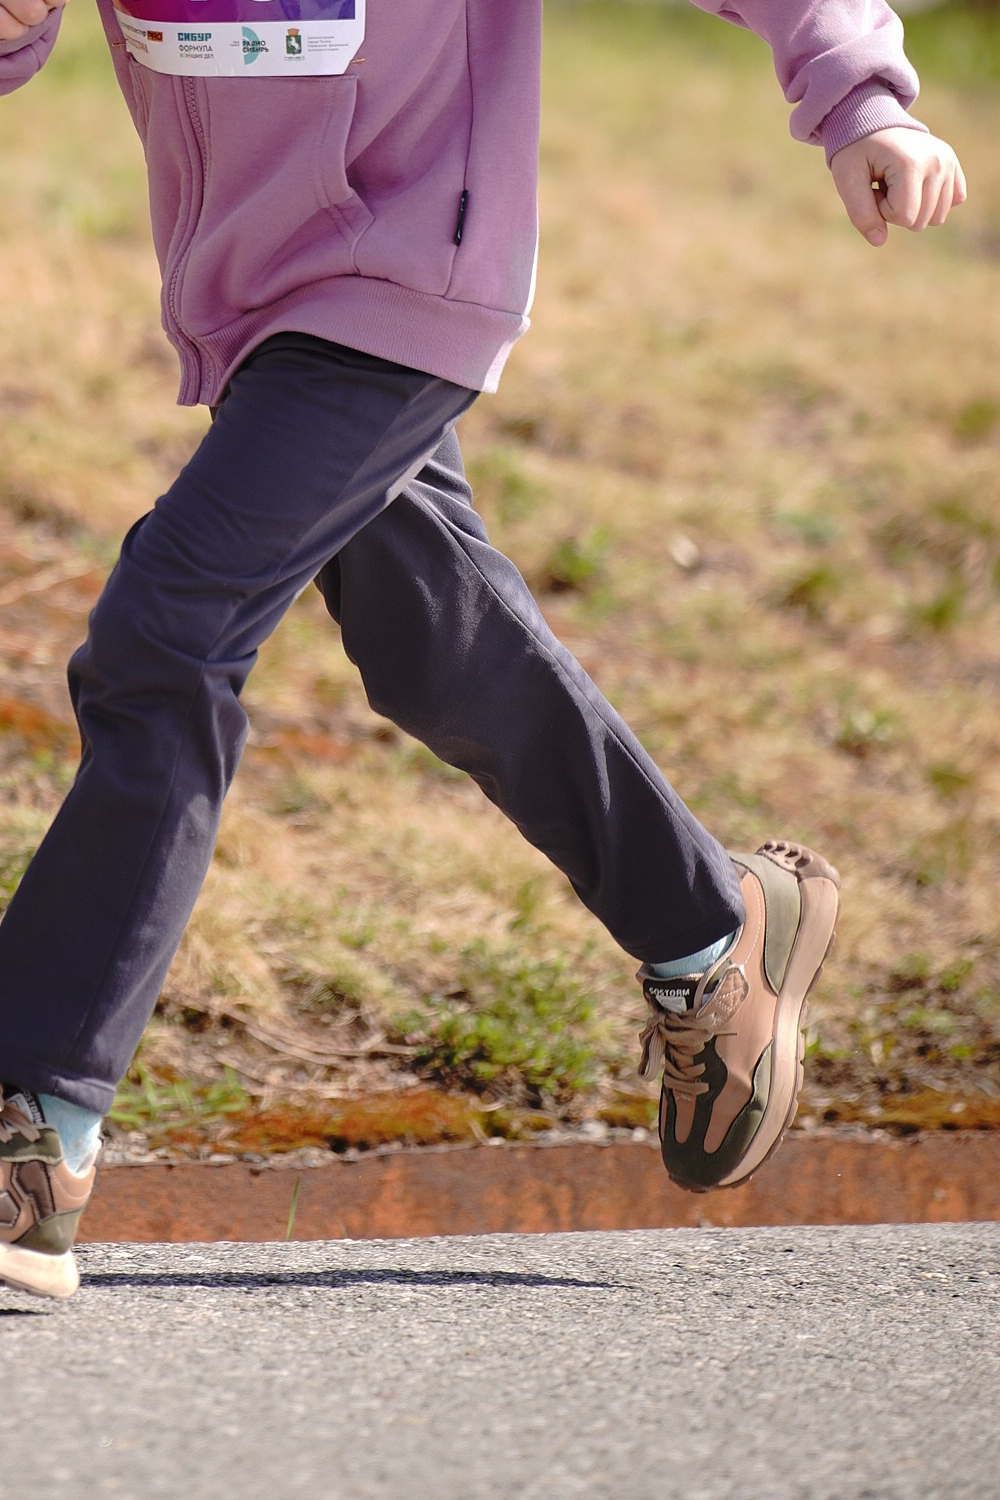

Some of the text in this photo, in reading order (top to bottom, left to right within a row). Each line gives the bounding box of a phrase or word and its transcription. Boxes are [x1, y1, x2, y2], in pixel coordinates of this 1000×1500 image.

[147, 30, 163, 41] PRO
[177, 32, 212, 42] СИБУР
[179, 44, 213, 53] ФОРМУЛА
